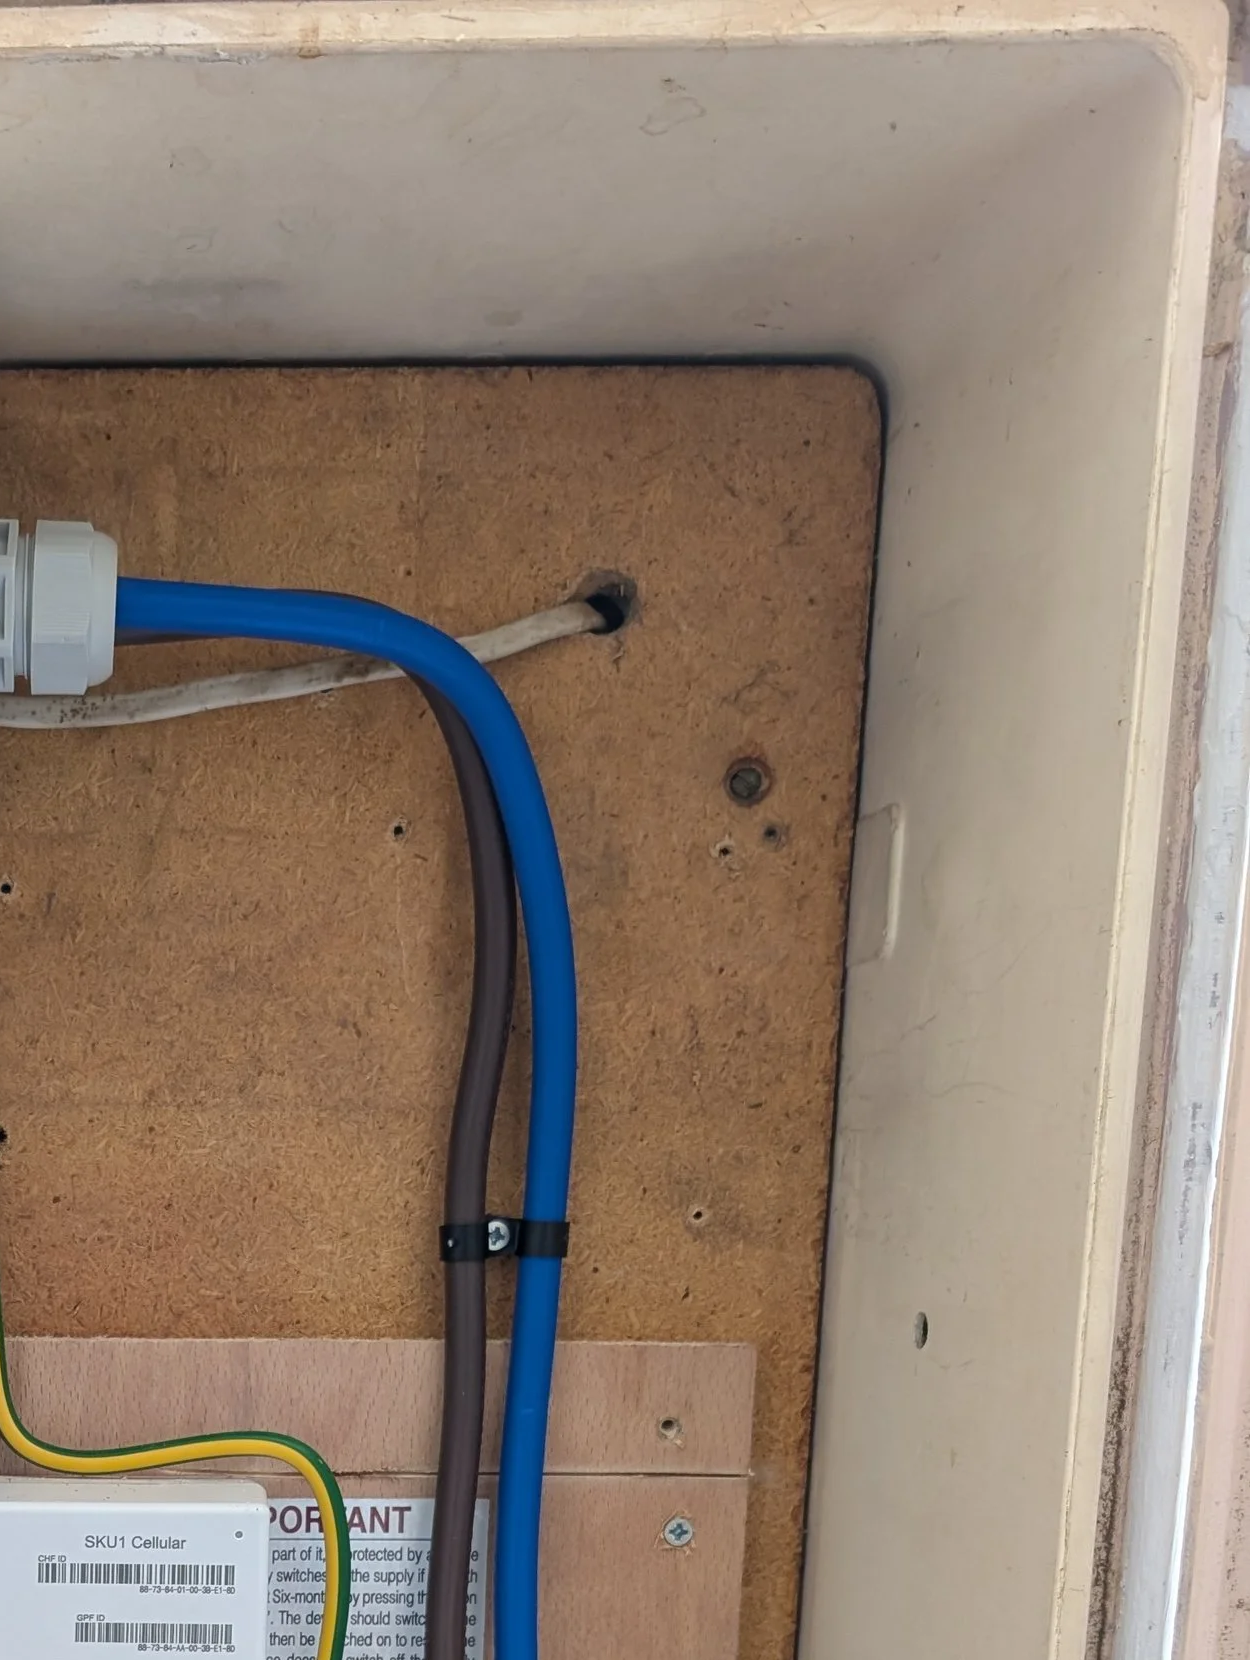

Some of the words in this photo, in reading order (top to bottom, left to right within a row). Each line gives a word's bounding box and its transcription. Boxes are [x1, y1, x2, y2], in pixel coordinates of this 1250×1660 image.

[85, 1535, 125, 1549] SKU1
[131, 1536, 186, 1550] Cellular
[351, 1569, 370, 1582] the
[373, 1570, 414, 1586] supply
[362, 1592, 414, 1607] pressing
[280, 1611, 300, 1625] The
[350, 1612, 390, 1626] should
[269, 1632, 295, 1646] then
